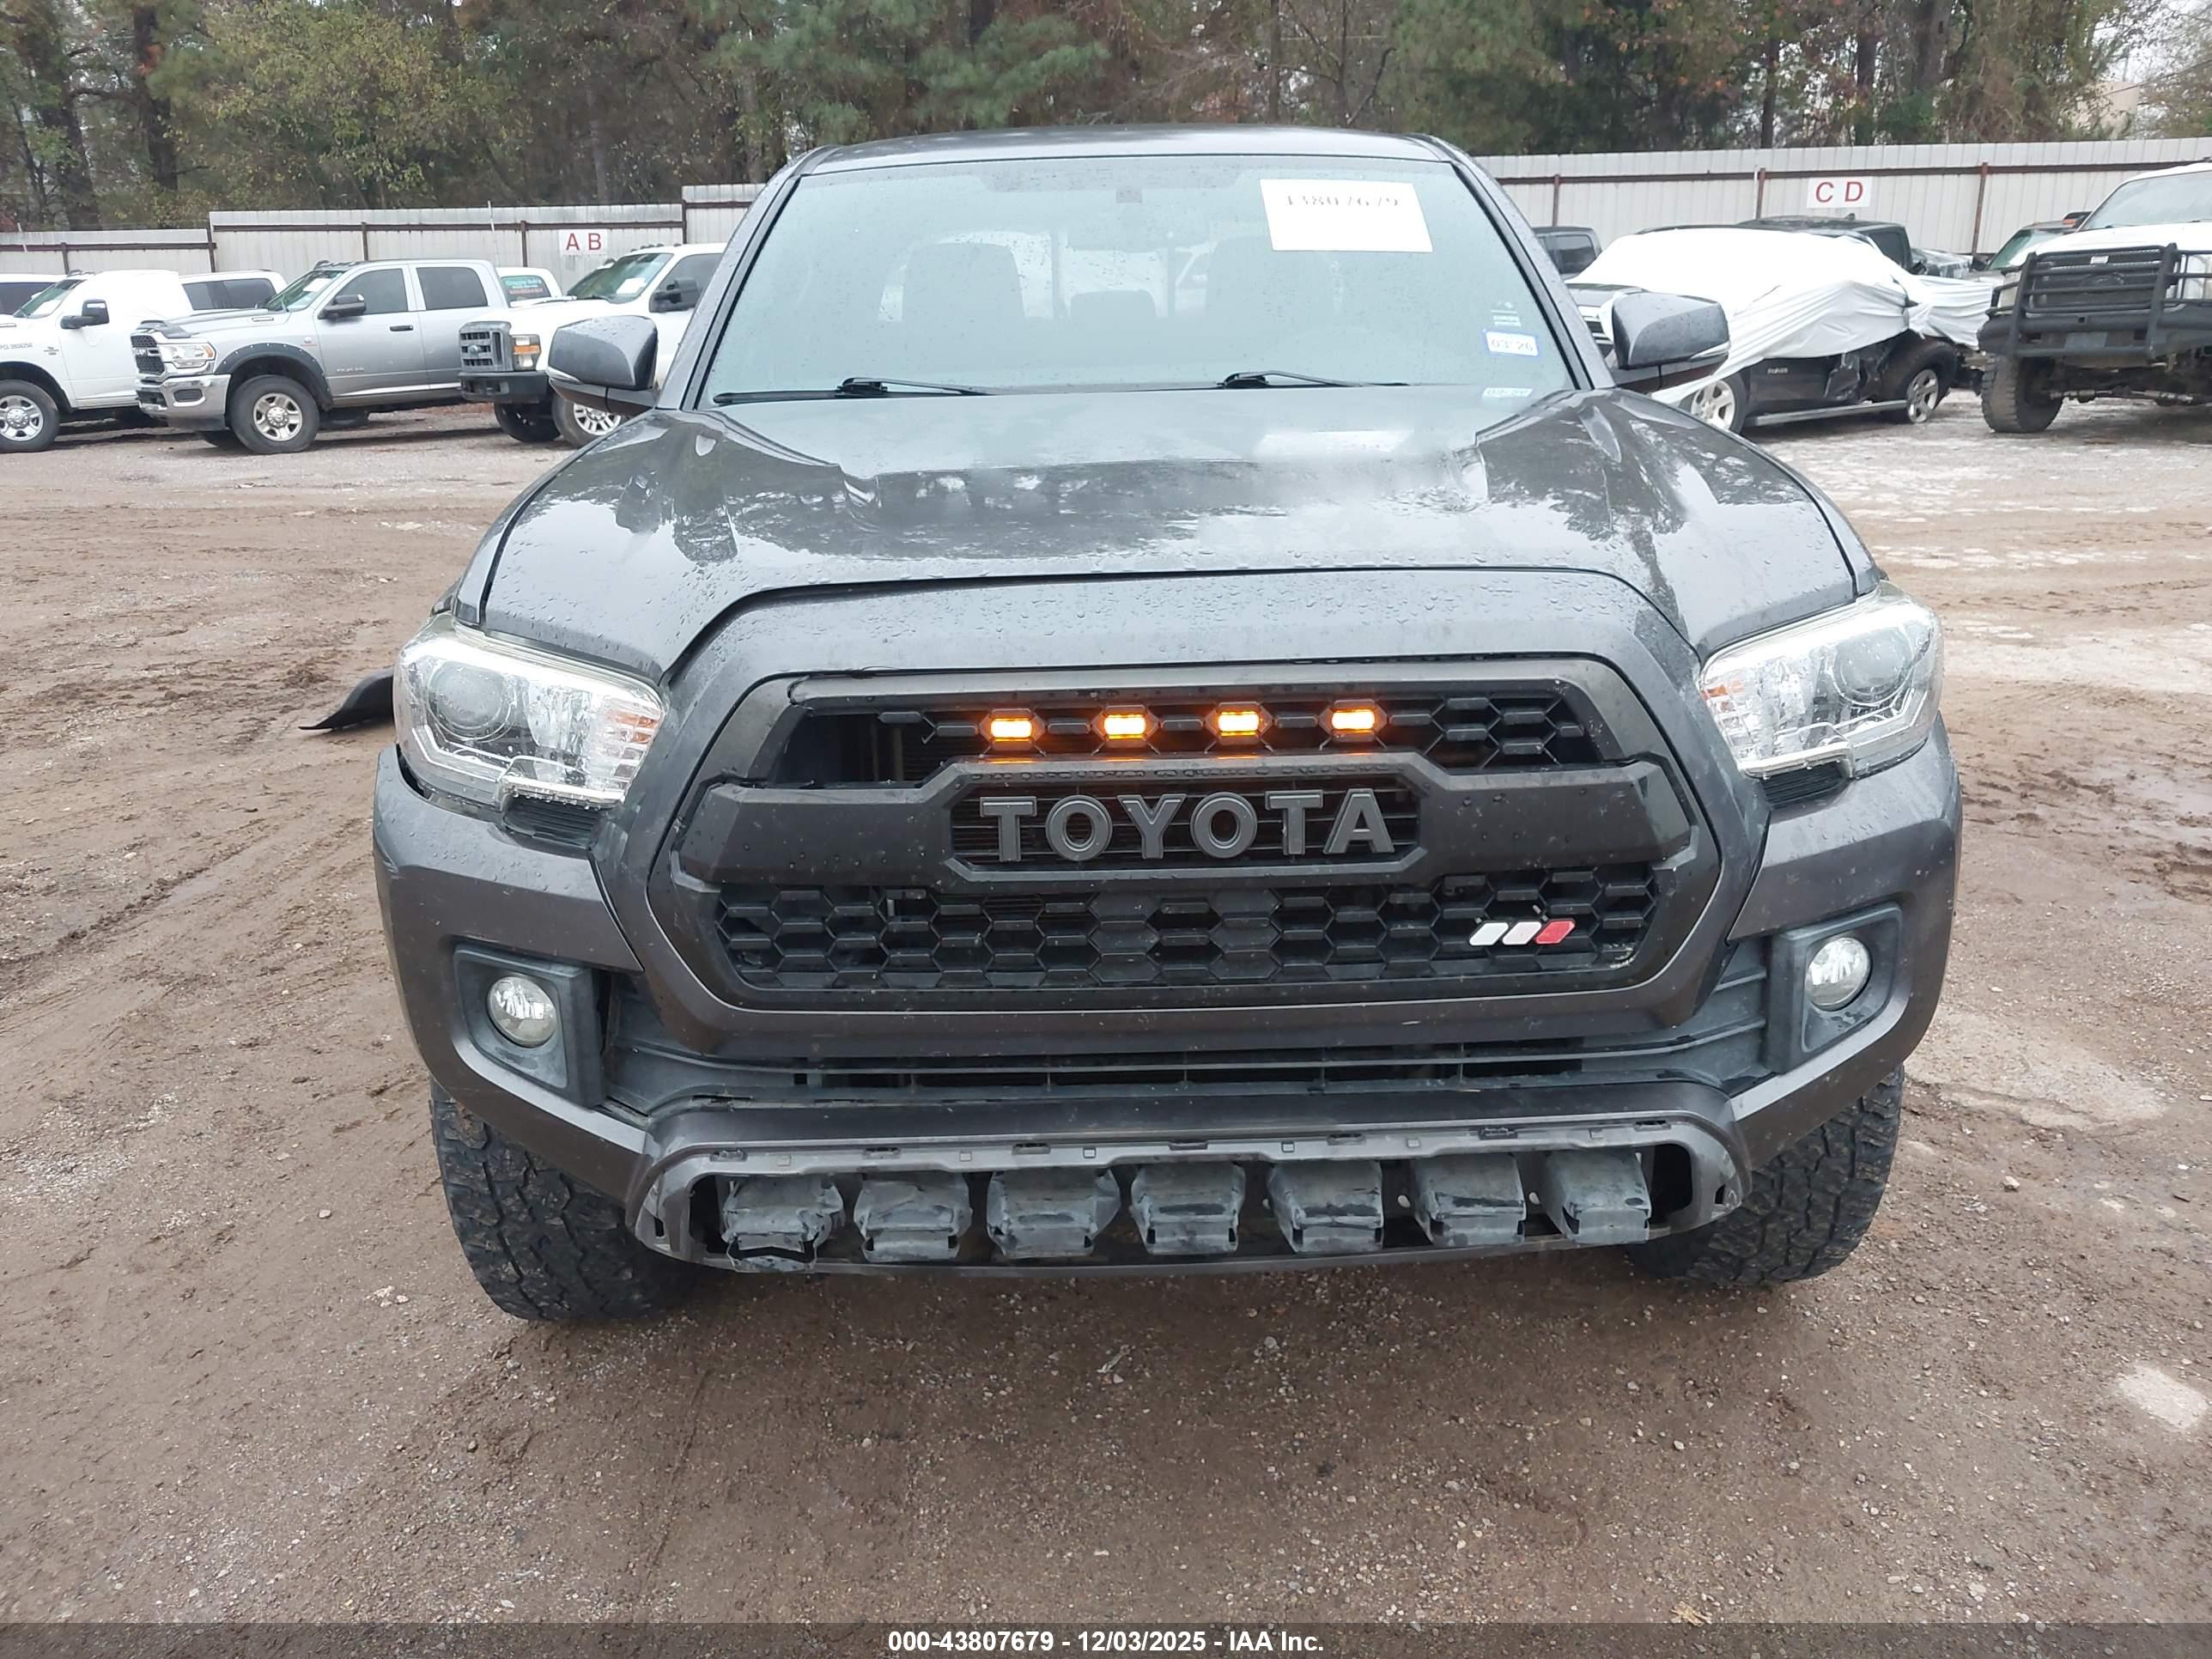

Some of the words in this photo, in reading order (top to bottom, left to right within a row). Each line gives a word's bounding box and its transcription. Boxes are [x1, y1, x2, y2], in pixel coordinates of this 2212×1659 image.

[1815, 181, 1834, 203] C
[1844, 181, 1863, 202] D
[566, 233, 580, 251] A
[587, 233, 602, 251] B
[979, 787, 1395, 861] TOYOTA
